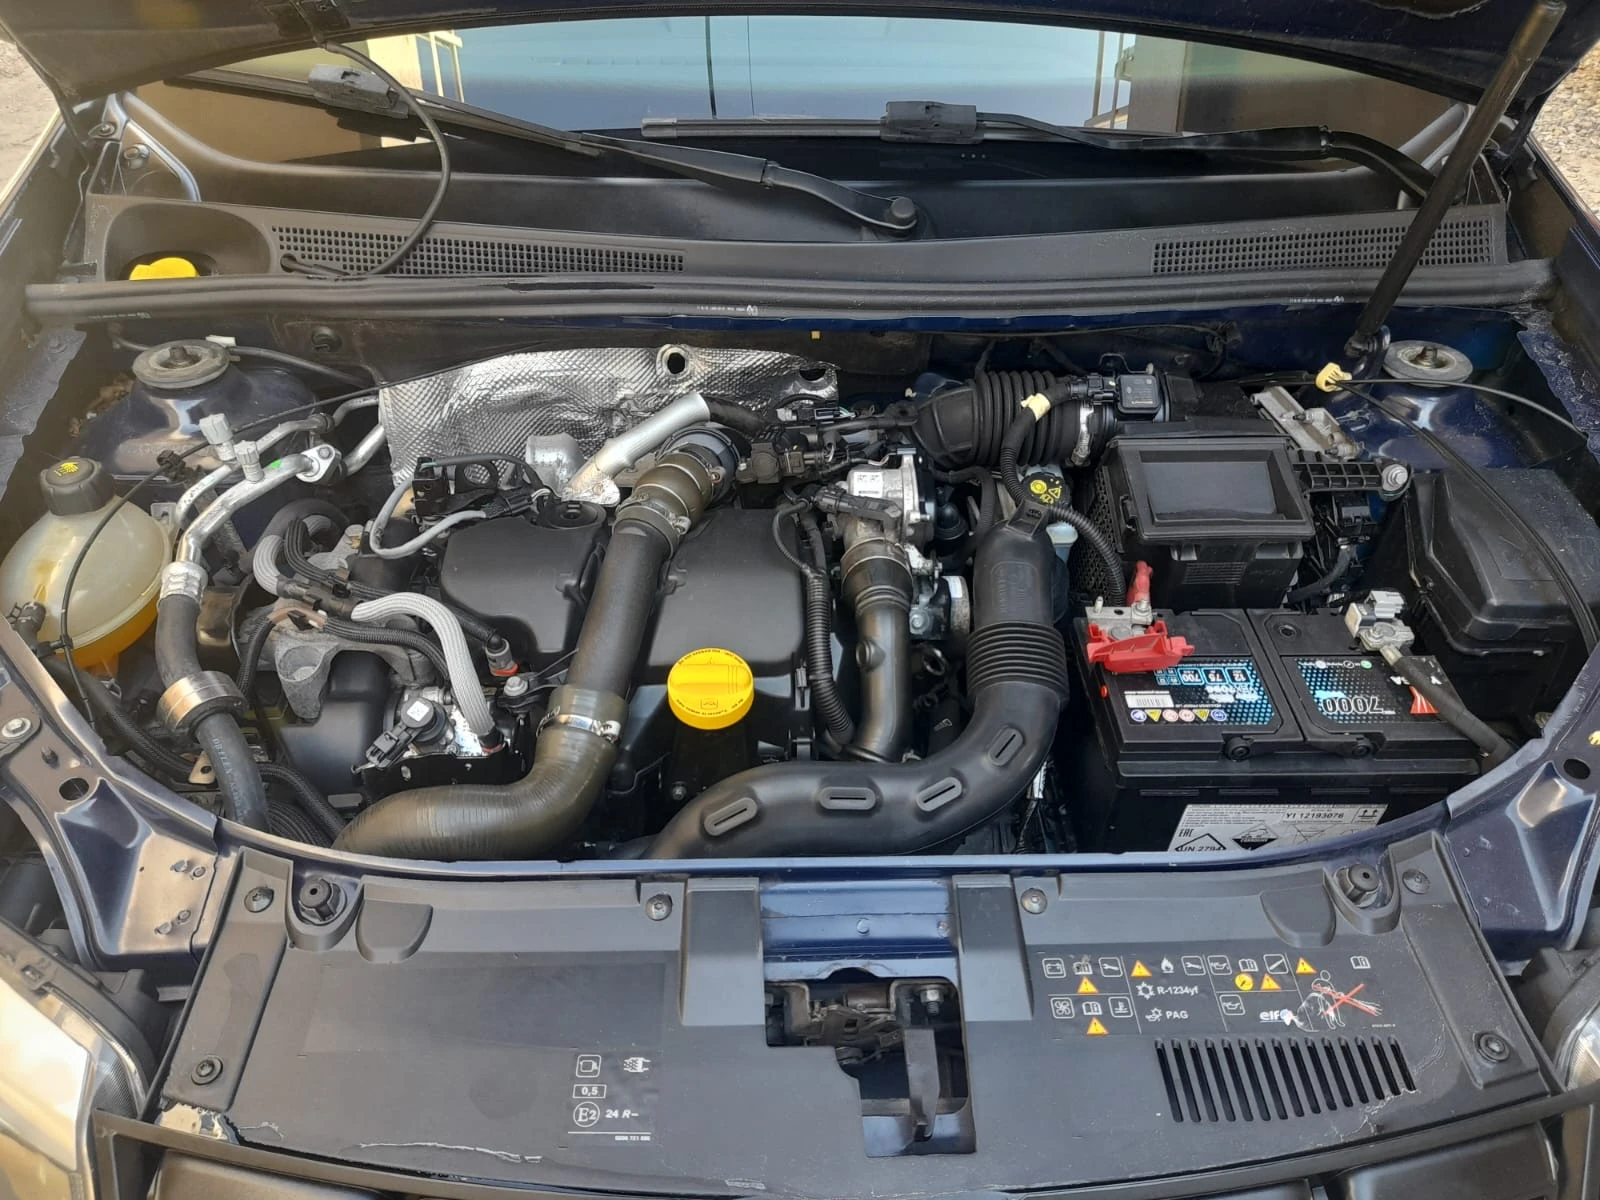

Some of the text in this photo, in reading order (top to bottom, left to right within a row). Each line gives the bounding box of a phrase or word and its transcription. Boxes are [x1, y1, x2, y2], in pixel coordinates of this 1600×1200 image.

[1183, 672, 1200, 682] 700
[1208, 672, 1222, 682] 75
[1234, 672, 1245, 681] 12
[1321, 696, 1384, 714] 7000
[1156, 985, 1199, 996] R-1234yf
[1165, 1010, 1189, 1019] PAG
[1259, 1009, 1280, 1021] elf
[581, 1086, 598, 1096] 0,5
[578, 1107, 597, 1121] E2
[605, 1109, 619, 1119] 24
